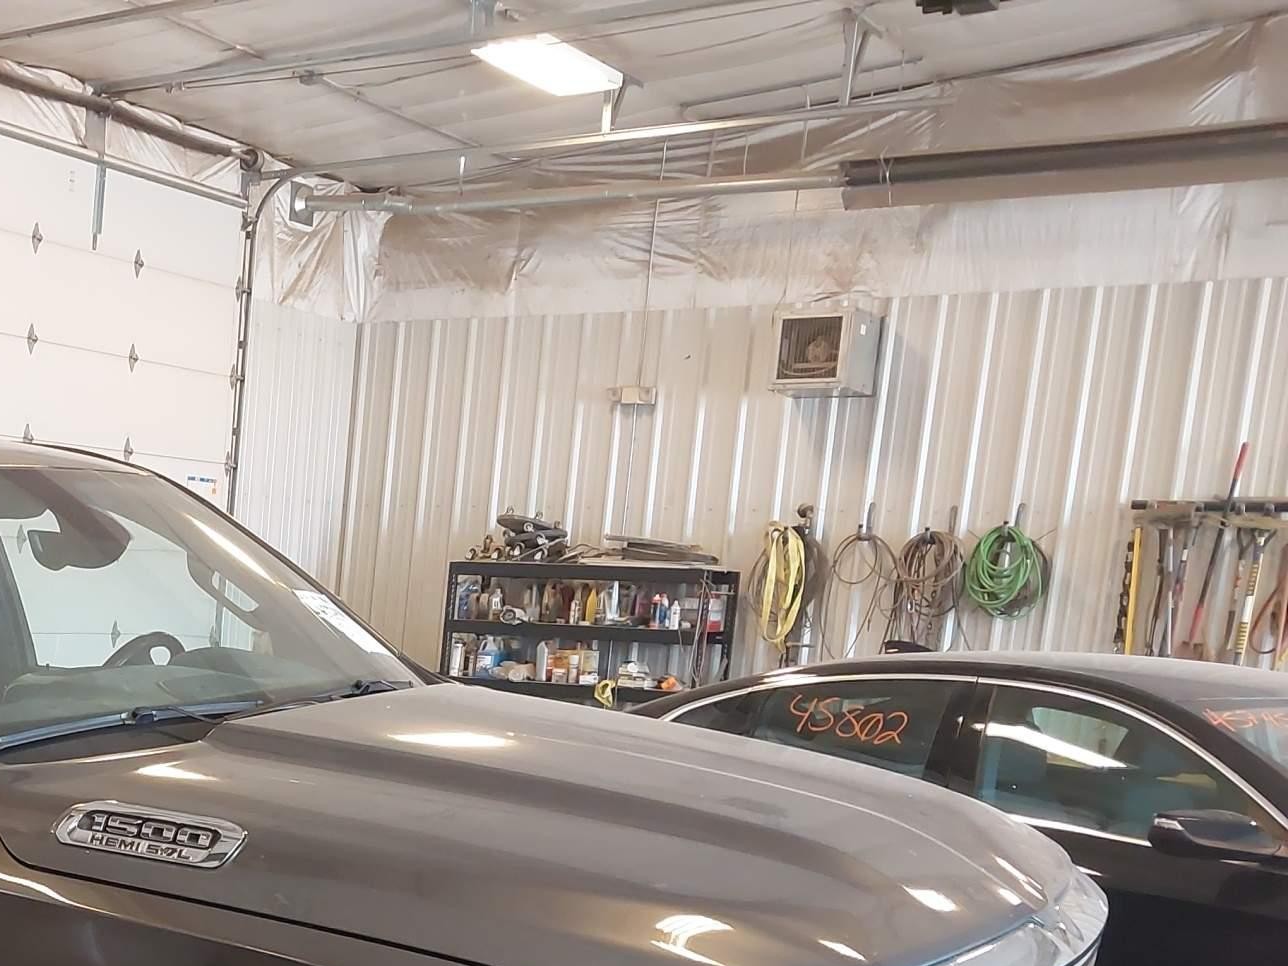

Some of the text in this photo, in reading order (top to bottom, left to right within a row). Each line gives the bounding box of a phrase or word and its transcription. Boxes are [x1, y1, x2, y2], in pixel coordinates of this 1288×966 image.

[789, 694, 909, 745] 45802
[89, 833, 141, 853] HEMI
[90, 812, 213, 848] 1500
